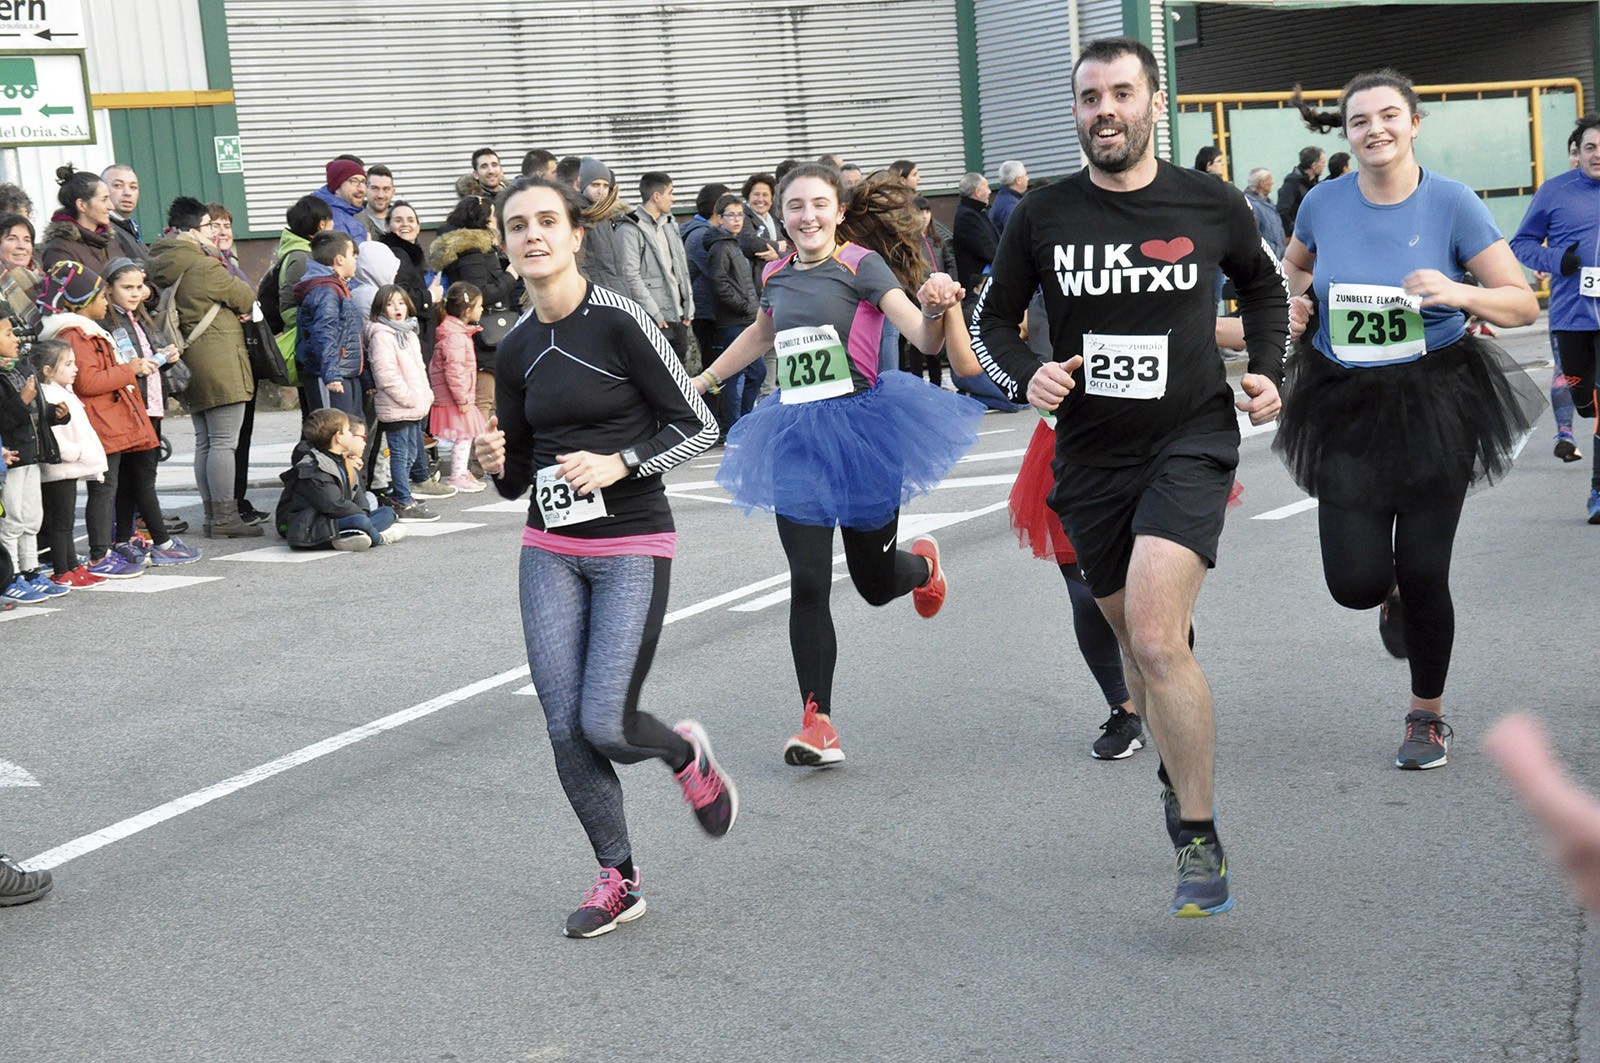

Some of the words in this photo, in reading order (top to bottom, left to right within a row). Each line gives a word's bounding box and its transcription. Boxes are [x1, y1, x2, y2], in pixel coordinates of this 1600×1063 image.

[0, 0, 46, 21] ern
[60, 124, 88, 137] S.A.
[1053, 243, 1133, 272] NIK
[1056, 263, 1198, 297] WUITXU
[1583, 276, 1600, 289] 3
[1336, 294, 1373, 304] ZUNBELTZ
[1377, 295, 1412, 309] ELKARTEA
[1347, 308, 1407, 346] 235
[786, 349, 836, 388] 232
[1091, 354, 1160, 383] 233
[1089, 380, 1119, 390] orrua
[540, 483, 596, 512] 234
